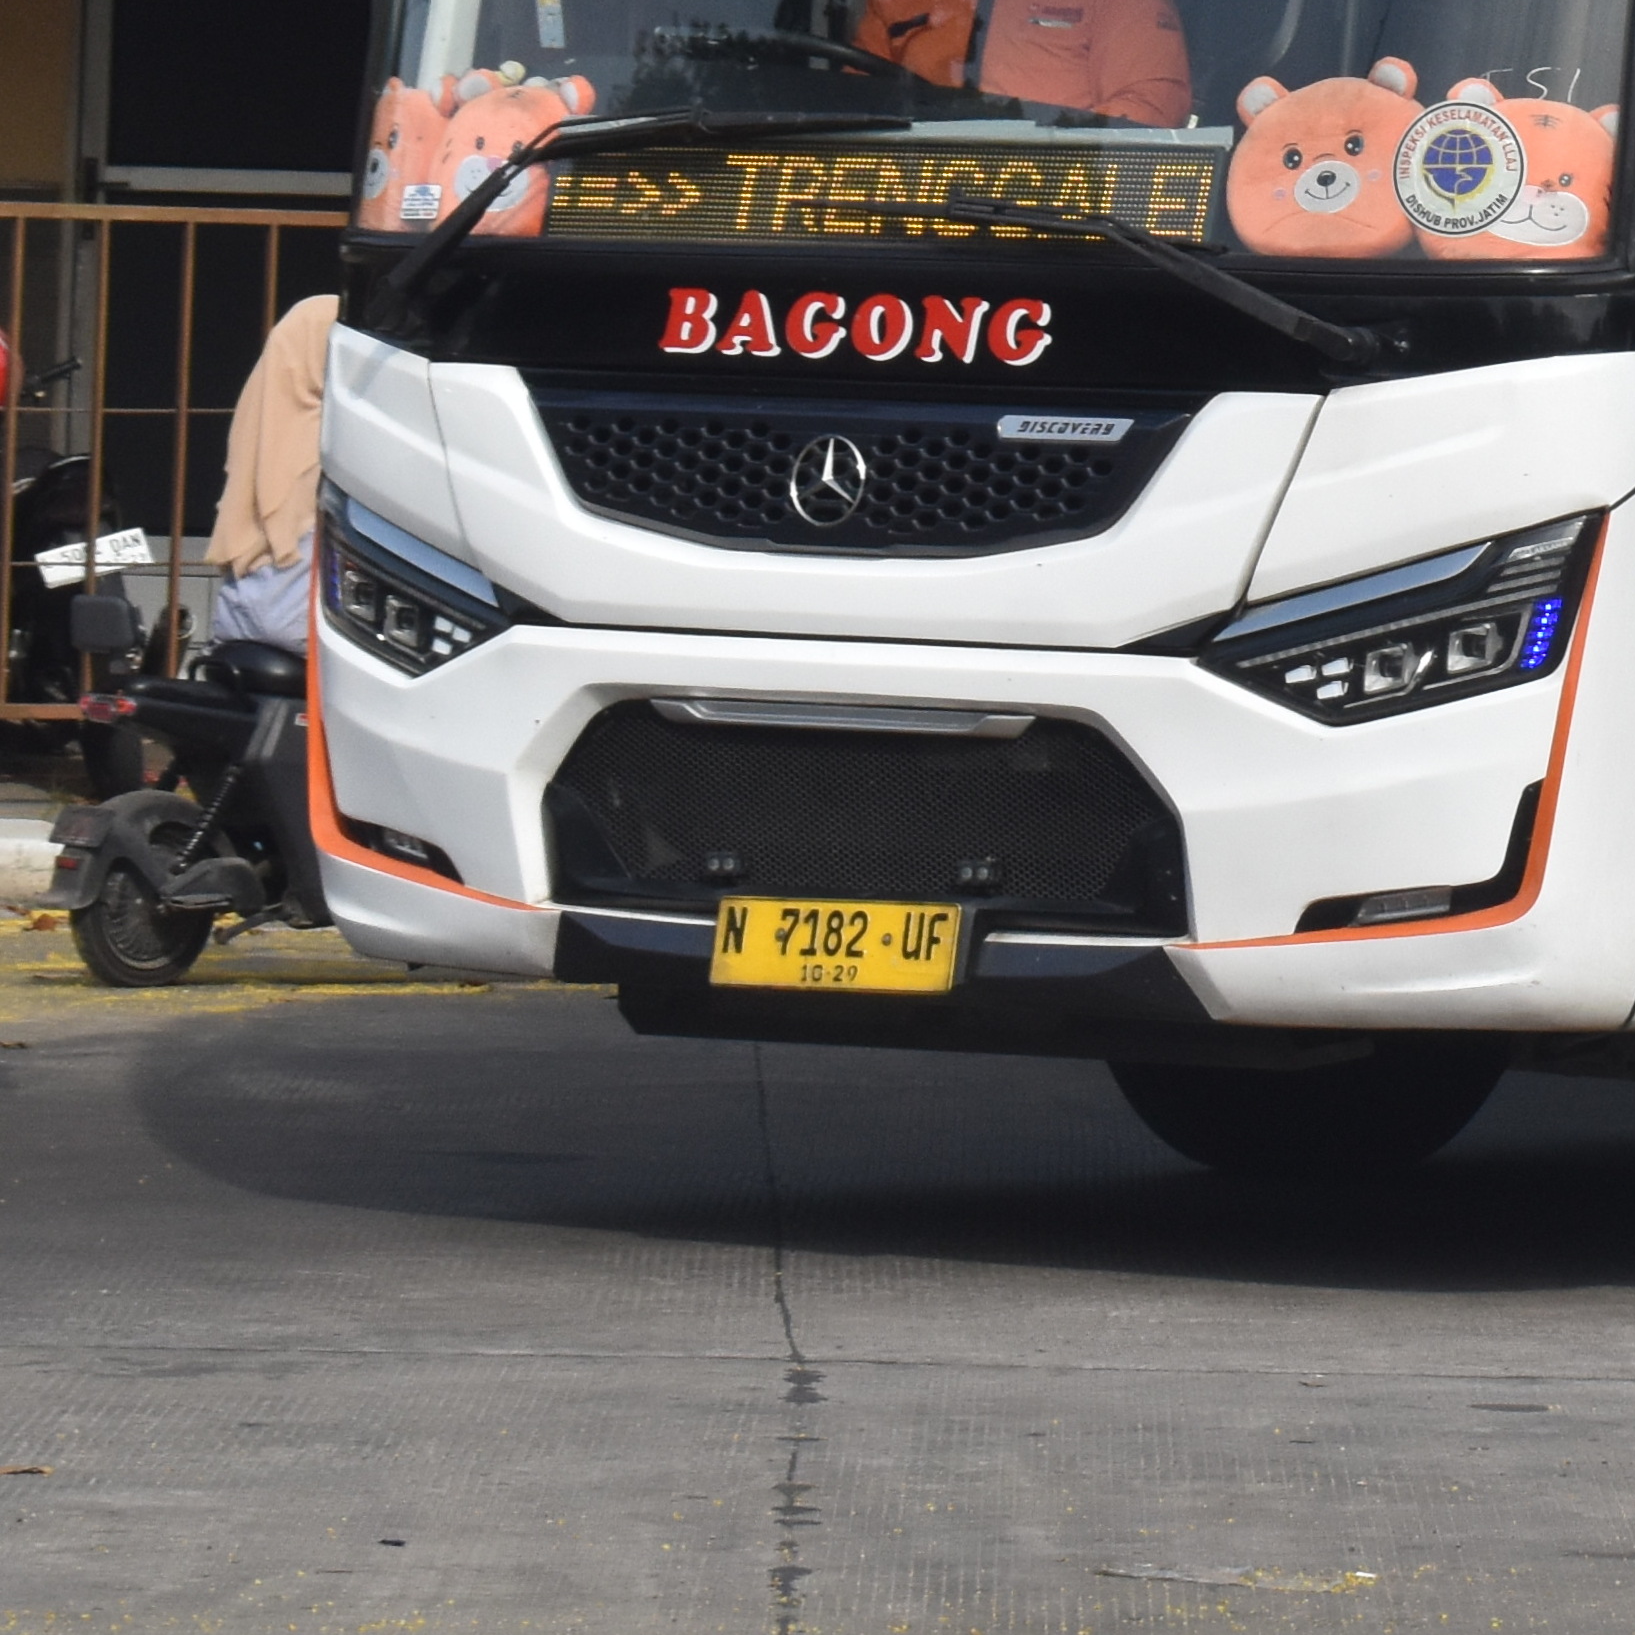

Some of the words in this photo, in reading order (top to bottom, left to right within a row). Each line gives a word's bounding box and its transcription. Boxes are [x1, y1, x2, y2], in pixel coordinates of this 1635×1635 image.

[1399, 125, 1428, 180] INSPEKSI
[1426, 109, 1510, 144] KESELAMATAN
[1404, 193, 1443, 227] DISHUB
[658, 286, 1053, 367] BAGONG
[1017, 420, 1116, 436] DISCOVERY
[722, 905, 749, 954] N
[779, 907, 870, 958] 7182
[902, 912, 950, 962] UF
